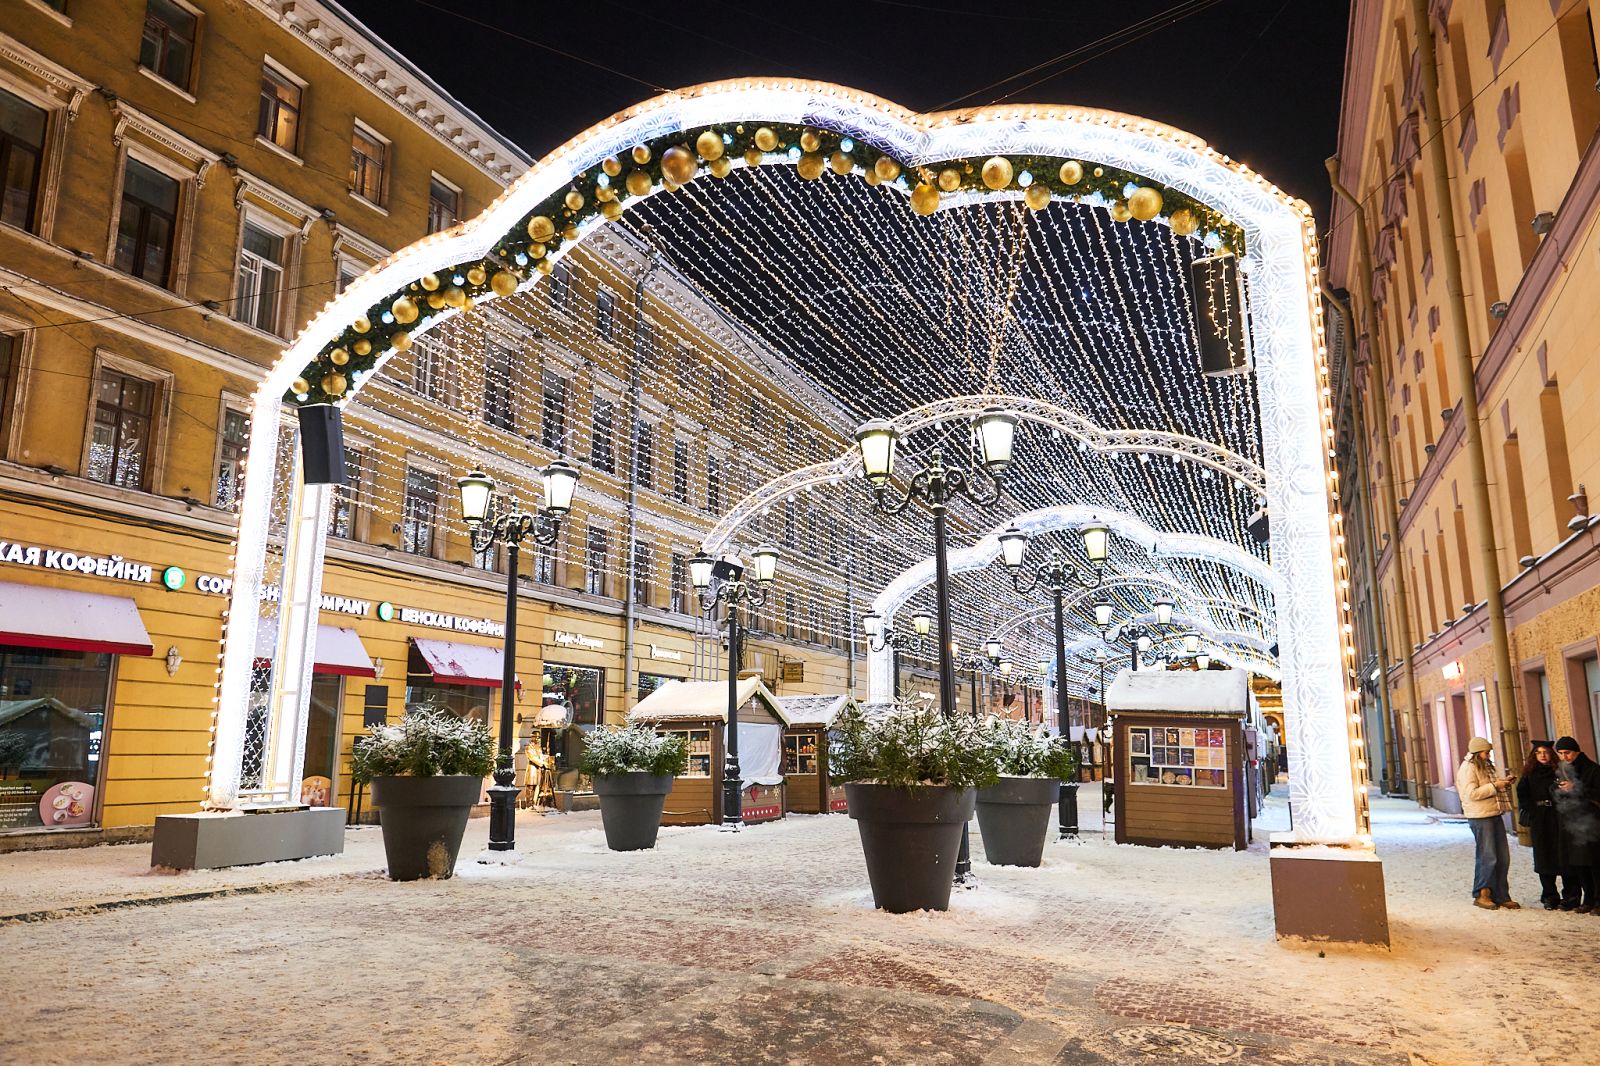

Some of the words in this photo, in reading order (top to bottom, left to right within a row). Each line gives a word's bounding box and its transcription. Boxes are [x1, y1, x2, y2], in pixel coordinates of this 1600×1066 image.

[45, 549, 152, 583] КОФЕЙНЯ
[402, 608, 453, 628] ВЕНСКАЯ
[455, 617, 505, 637] КОФЕЙНЯ
